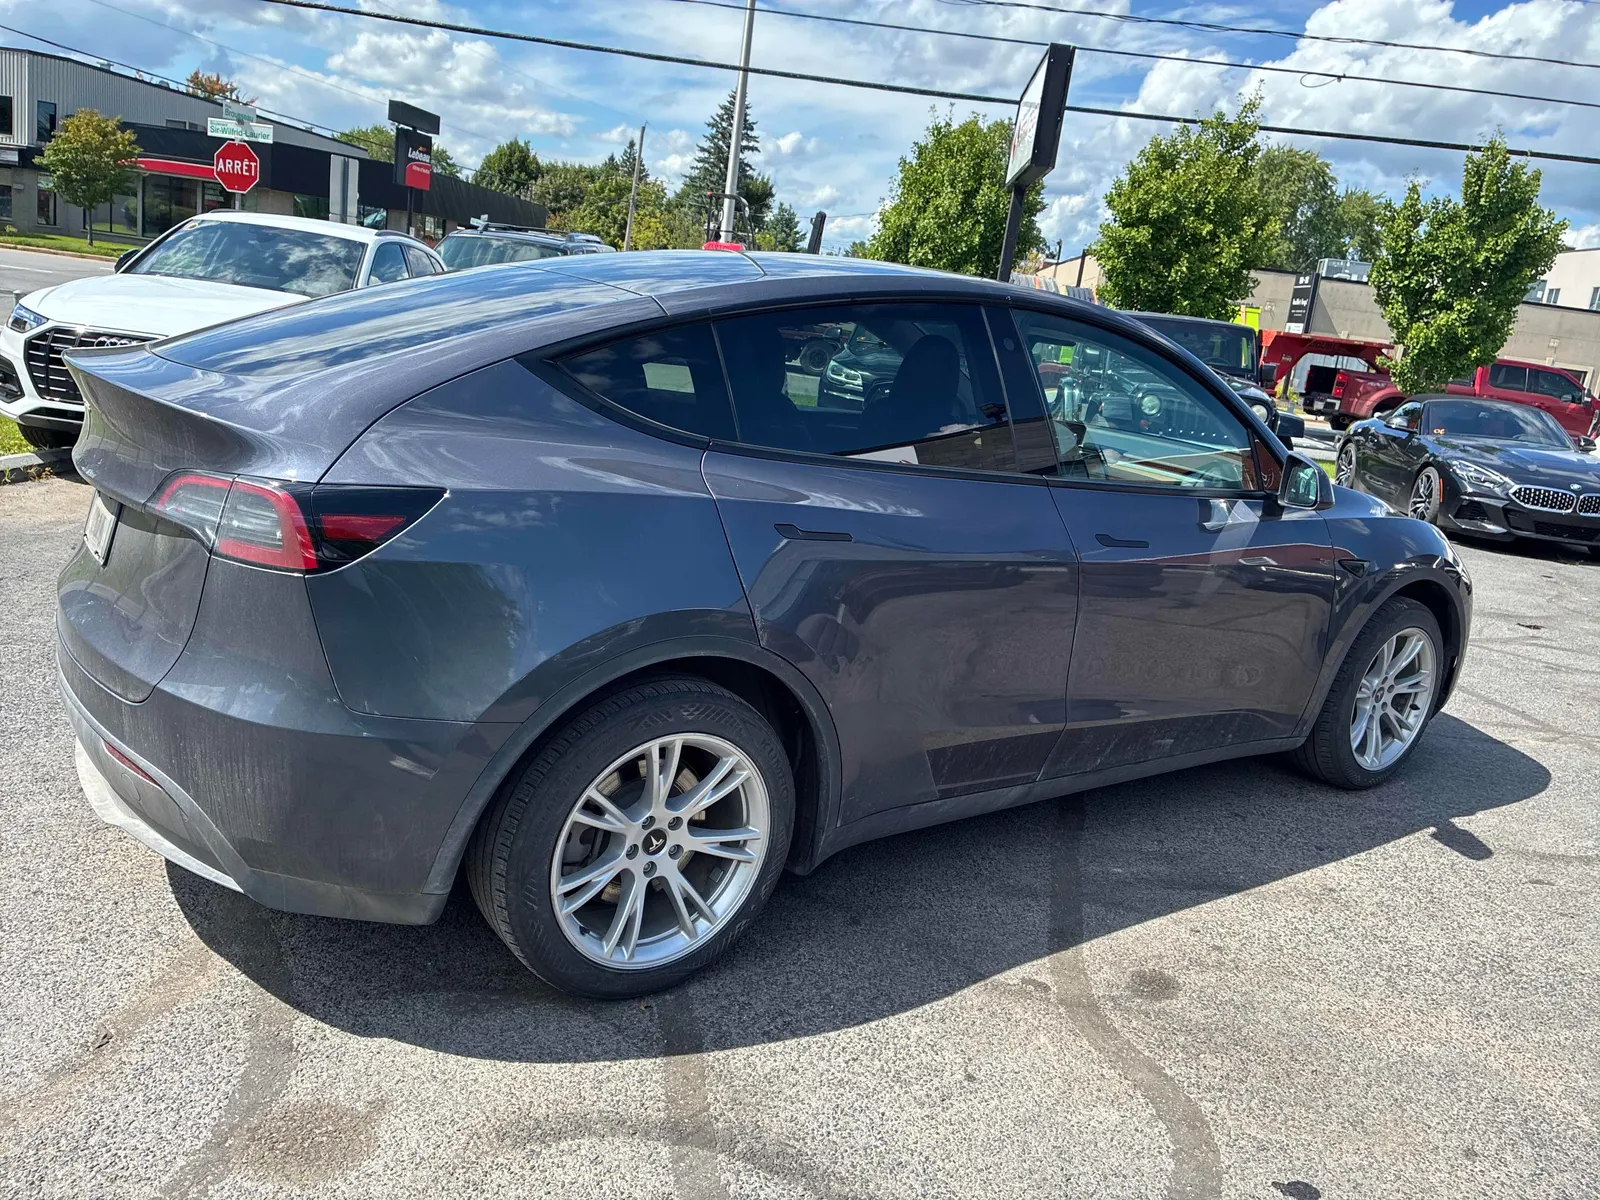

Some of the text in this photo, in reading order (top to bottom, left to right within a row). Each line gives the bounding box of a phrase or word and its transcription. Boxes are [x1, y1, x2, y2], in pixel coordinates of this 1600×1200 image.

[210, 125, 270, 140] Sir-Wilfrid-Laurier
[408, 147, 431, 163] Lebeau
[217, 158, 257, 176] ARRÊT
